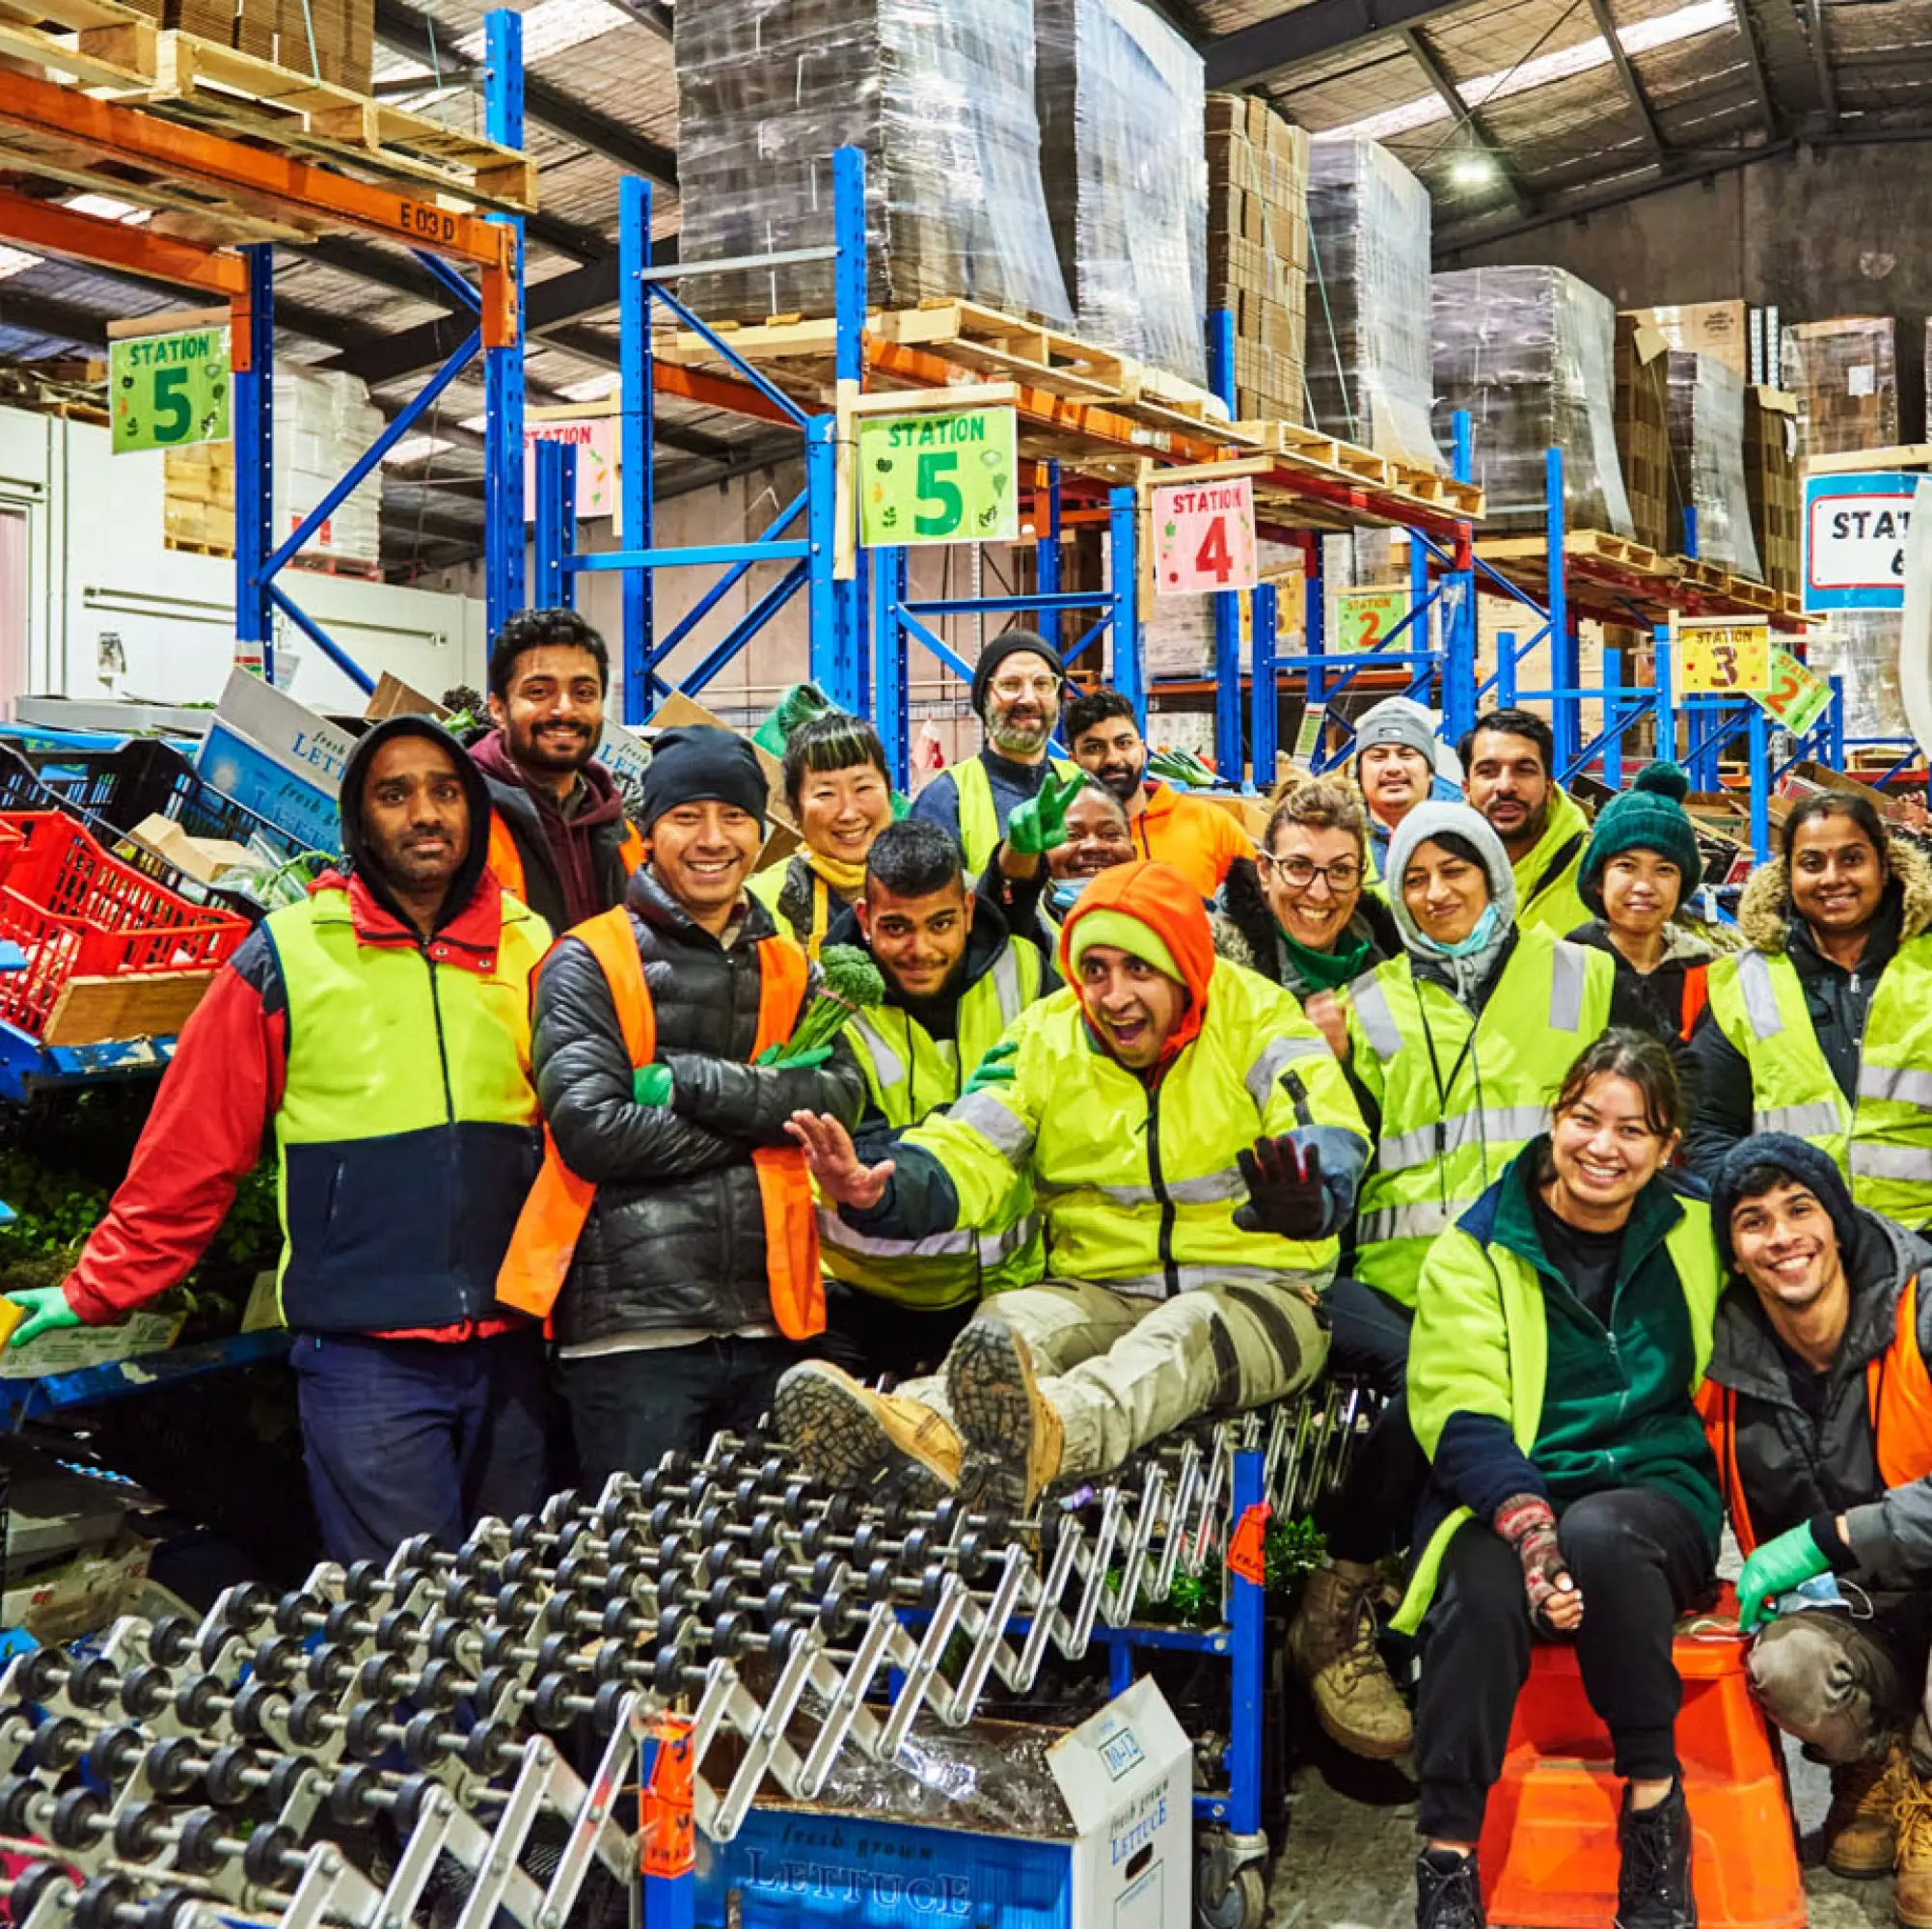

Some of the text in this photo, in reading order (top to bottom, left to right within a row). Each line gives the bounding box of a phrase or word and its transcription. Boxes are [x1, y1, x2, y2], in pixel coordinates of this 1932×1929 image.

[400, 202, 455, 240] E 03 D
[130, 335, 209, 367] STATION
[153, 367, 191, 442] 5
[888, 417, 984, 448] STATION
[914, 451, 963, 535] 5
[1174, 488, 1241, 514] STATION
[1195, 516, 1233, 584] 4
[1358, 611, 1382, 647] 2
[1709, 646, 1738, 687] 3
[1764, 676, 1799, 714] 2
[1112, 1797, 1167, 1866] LETTUCE
[745, 1847, 972, 1919] LETTUCE
